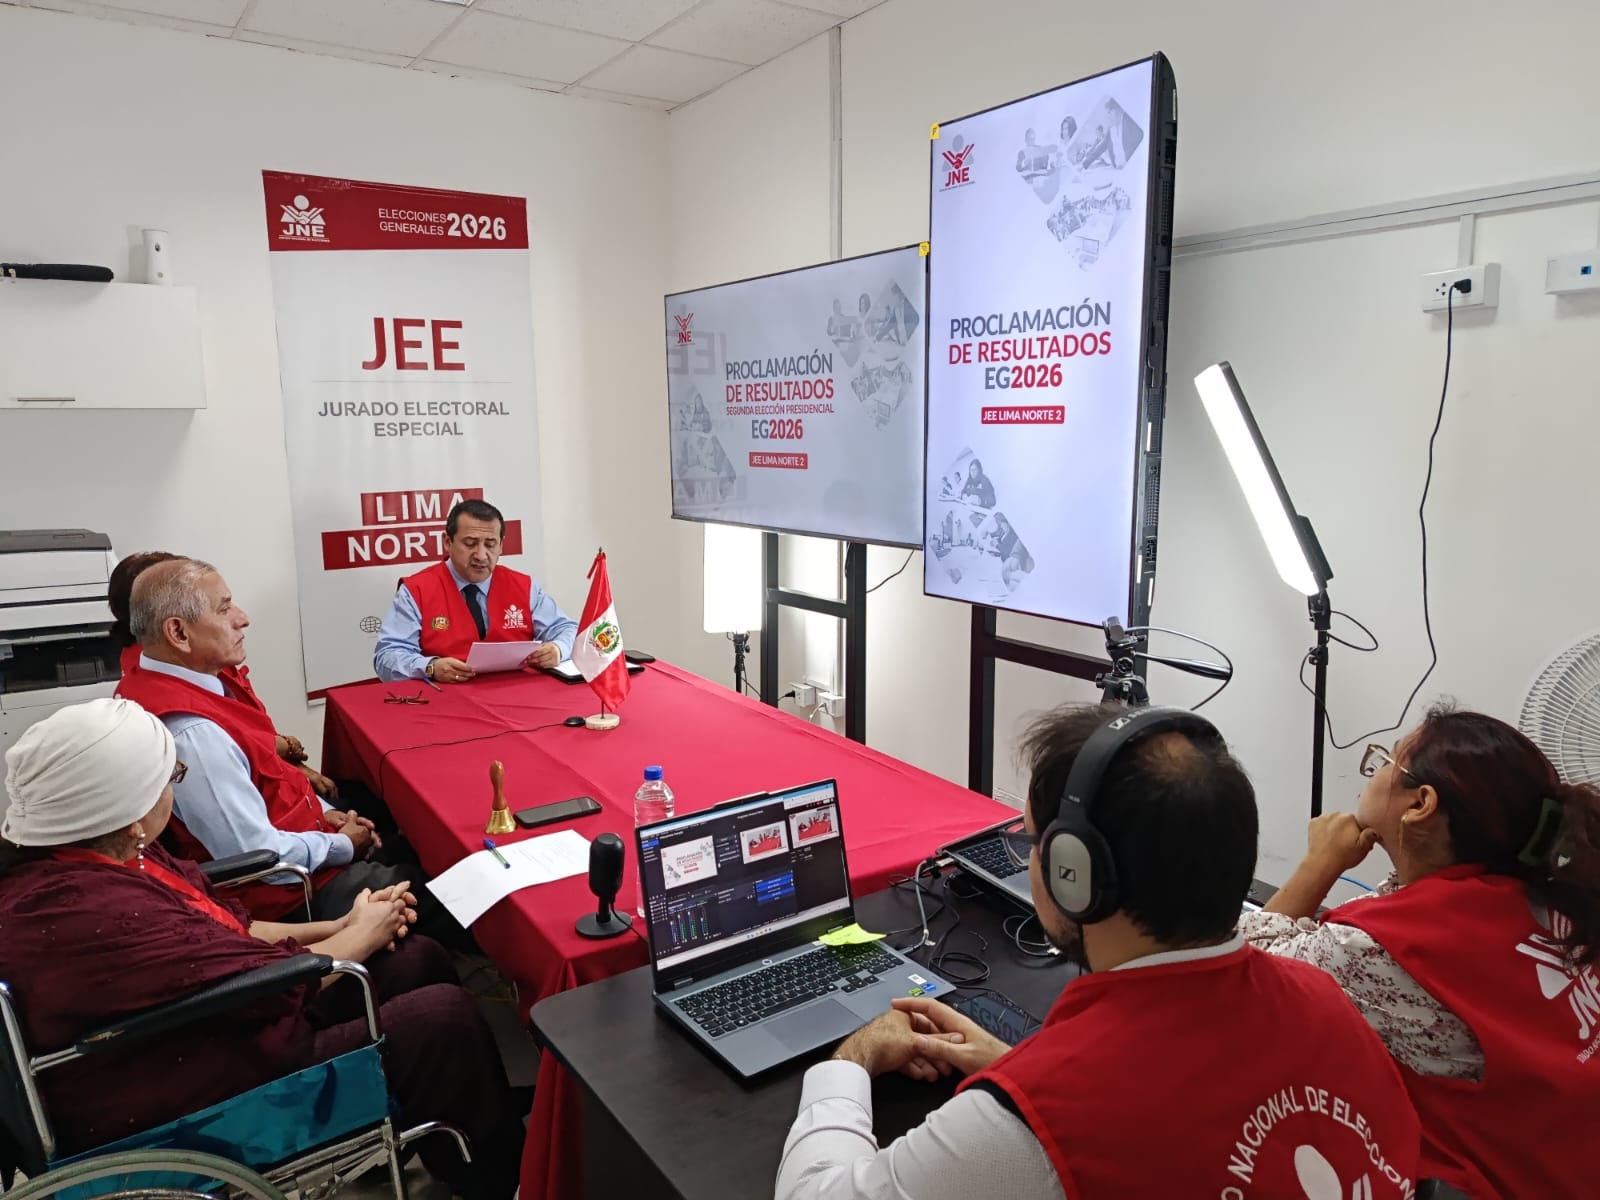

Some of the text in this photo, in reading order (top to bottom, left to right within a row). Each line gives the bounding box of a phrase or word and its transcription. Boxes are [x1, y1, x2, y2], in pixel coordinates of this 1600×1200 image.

[945, 167, 970, 187] JNE
[378, 208, 447, 223] ELECCIONES
[282, 223, 325, 238] JNE
[379, 221, 444, 236] GENERALES
[447, 213, 507, 241] 2026
[950, 297, 1112, 340] PROCLAMACIÓN
[362, 317, 466, 371] JEE
[677, 330, 692, 344] JNE
[949, 331, 1112, 365] DE RESULTADOS
[725, 348, 833, 380] PROCLAMACIÓN
[984, 363, 1063, 390] EG2026
[726, 378, 834, 403] DE RESULTADOS
[318, 401, 510, 417] JURADO ELECTORAL
[726, 403, 835, 416] SEGUNDA ELECCIÓN PRESIDENCIAL
[983, 410, 1062, 421] JEE LIMA NORTE 2
[374, 422, 464, 437] ESPECIAL
[751, 418, 804, 440] EG2026
[751, 455, 805, 466] JEE LIMA NORTE 2
[347, 530, 445, 563] NORT
[1227, 1085, 1415, 1200] NACIONAL DE ELECCION
